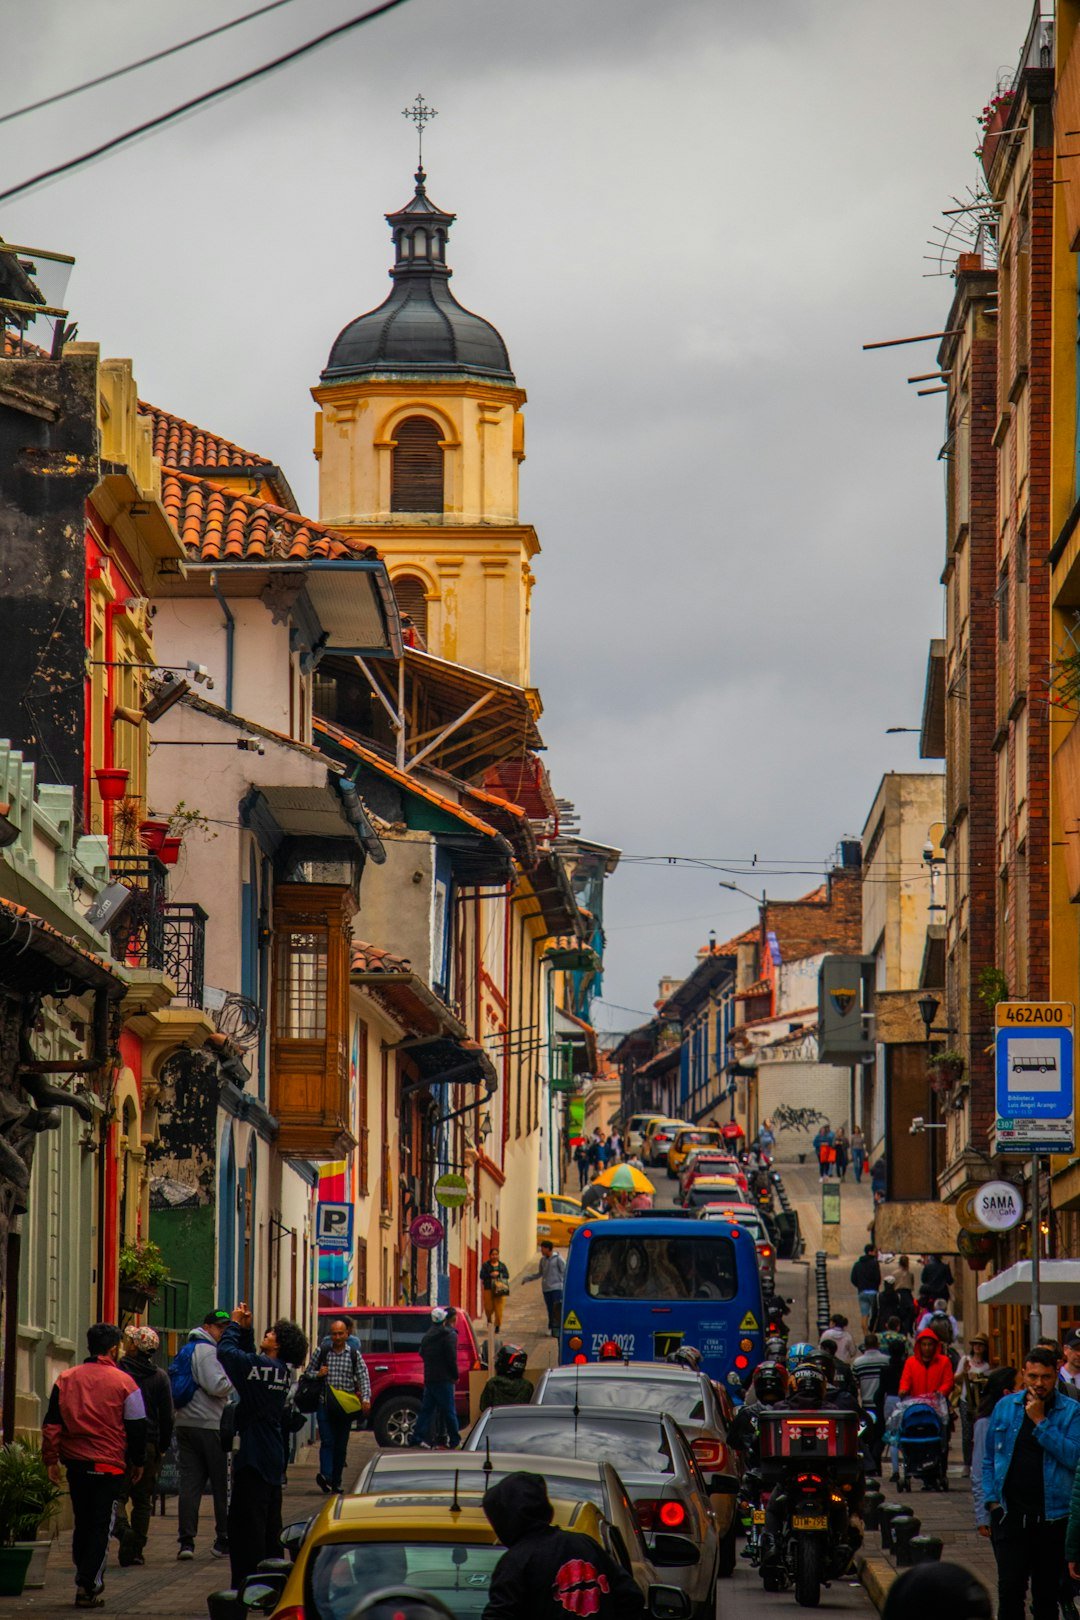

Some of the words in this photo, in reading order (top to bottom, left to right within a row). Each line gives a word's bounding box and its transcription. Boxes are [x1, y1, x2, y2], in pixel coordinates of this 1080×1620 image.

[1006, 1008, 1063, 1023] 462A00
[983, 1196, 1014, 1209] SAMA
[323, 1210, 347, 1233] P
